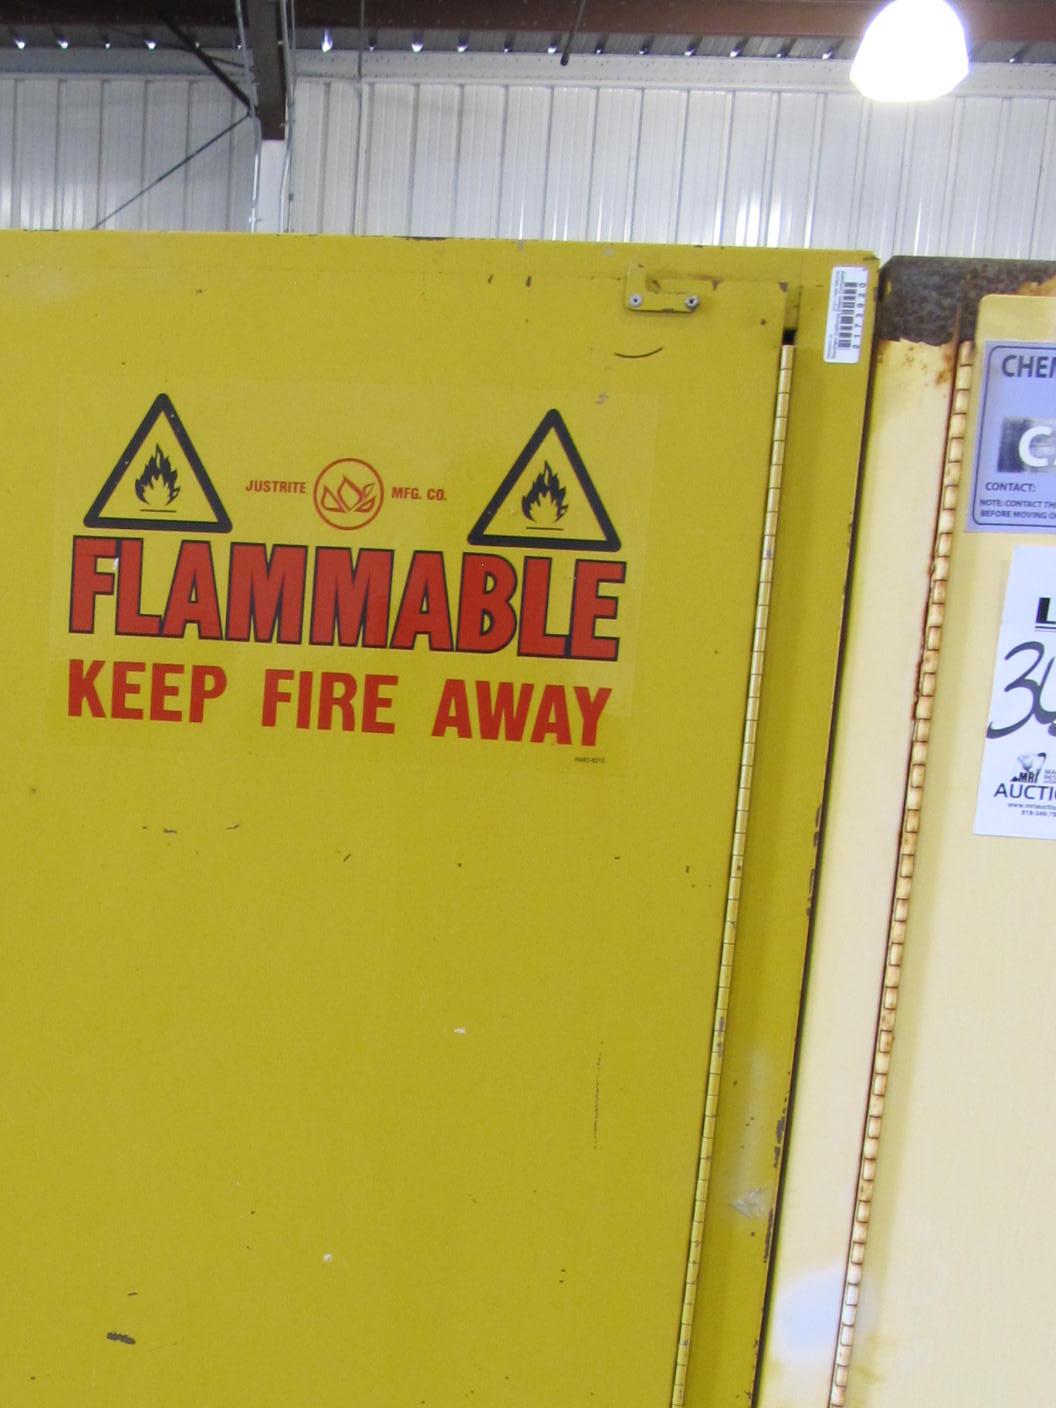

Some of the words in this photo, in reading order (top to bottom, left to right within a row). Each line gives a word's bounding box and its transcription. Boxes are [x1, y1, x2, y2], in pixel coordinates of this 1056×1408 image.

[246, 479, 307, 494] JUSTRITE
[391, 486, 422, 501] MFG.
[426, 488, 447, 502] CO.
[68, 534, 627, 662] FLAMMABLE
[67, 659, 227, 723] KEEP
[260, 668, 399, 734] FIRE
[431, 678, 613, 747] AWAY
[994, 783, 1056, 801] AUCTI
